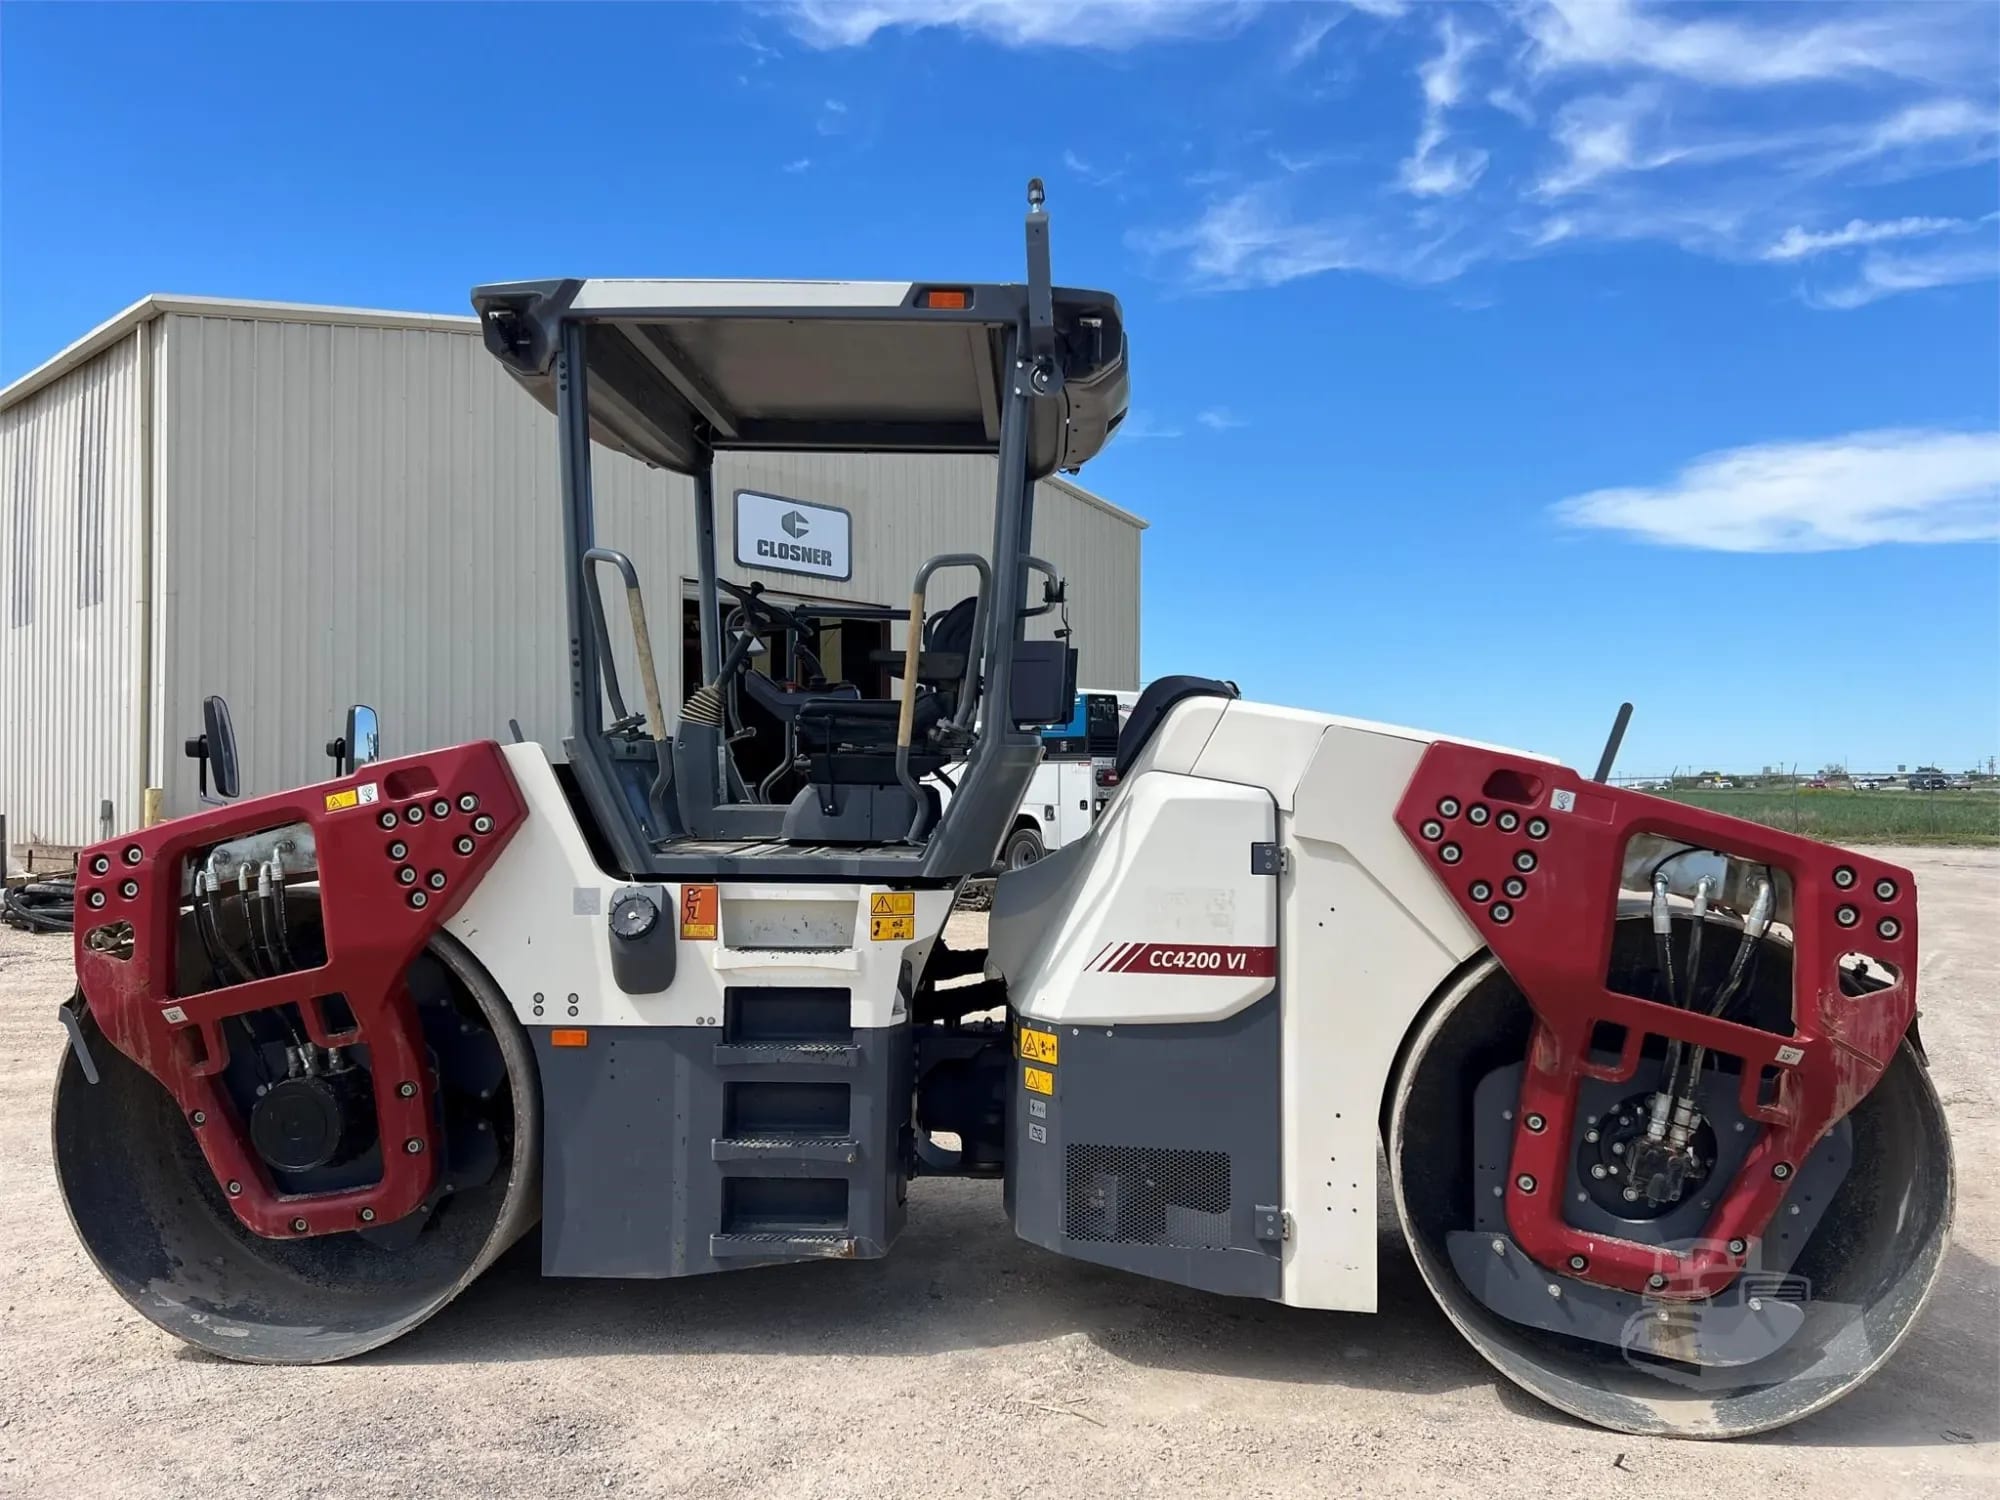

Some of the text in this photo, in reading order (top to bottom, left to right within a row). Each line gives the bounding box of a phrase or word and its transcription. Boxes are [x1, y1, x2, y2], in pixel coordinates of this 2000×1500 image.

[757, 539, 832, 567] CLOSNER
[1150, 951, 1247, 970] CC4200 VI
